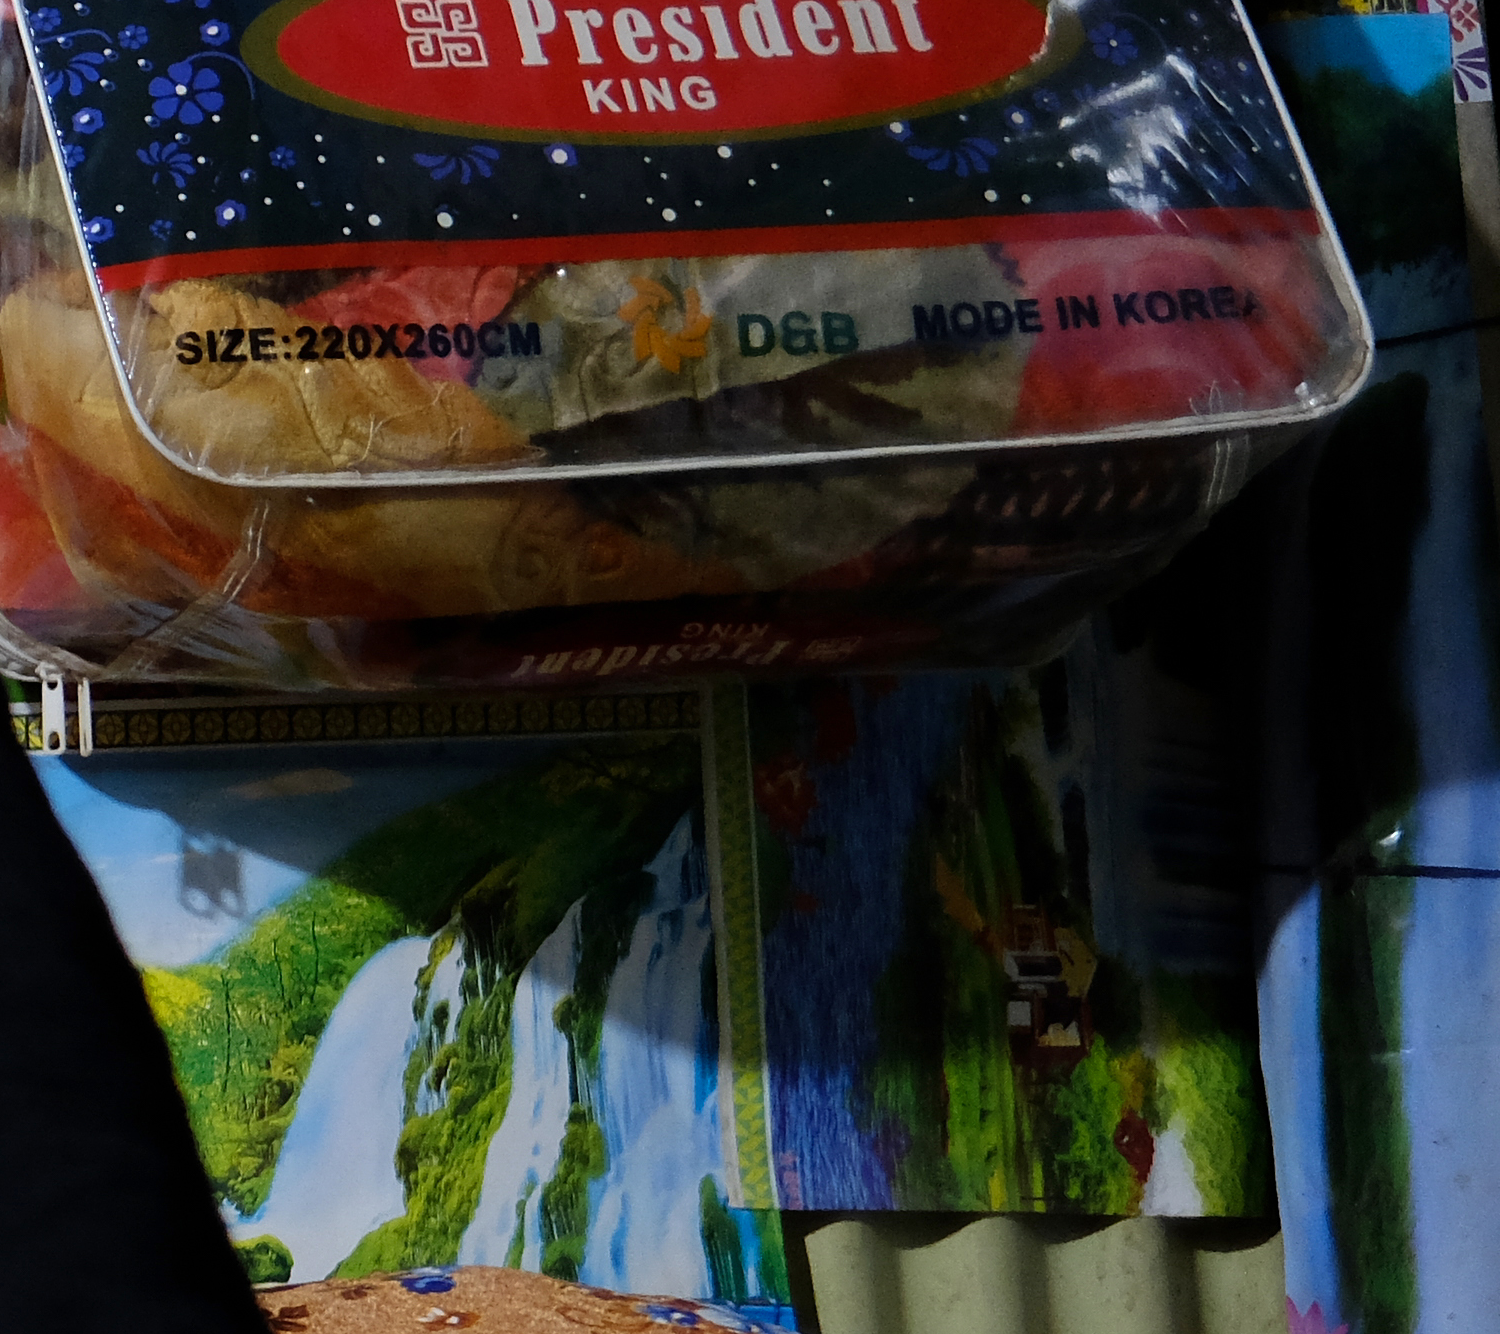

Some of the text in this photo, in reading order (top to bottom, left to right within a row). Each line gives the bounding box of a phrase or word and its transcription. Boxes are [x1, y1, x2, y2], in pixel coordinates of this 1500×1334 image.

[581, 75, 718, 114] KING
[736, 310, 860, 358] D&B
[911, 298, 1044, 342] MODE
[1055, 294, 1100, 330] IN
[175, 321, 542, 366] SIZE:220X260CM
[679, 622, 771, 639] KING
[509, 639, 791, 679] President
